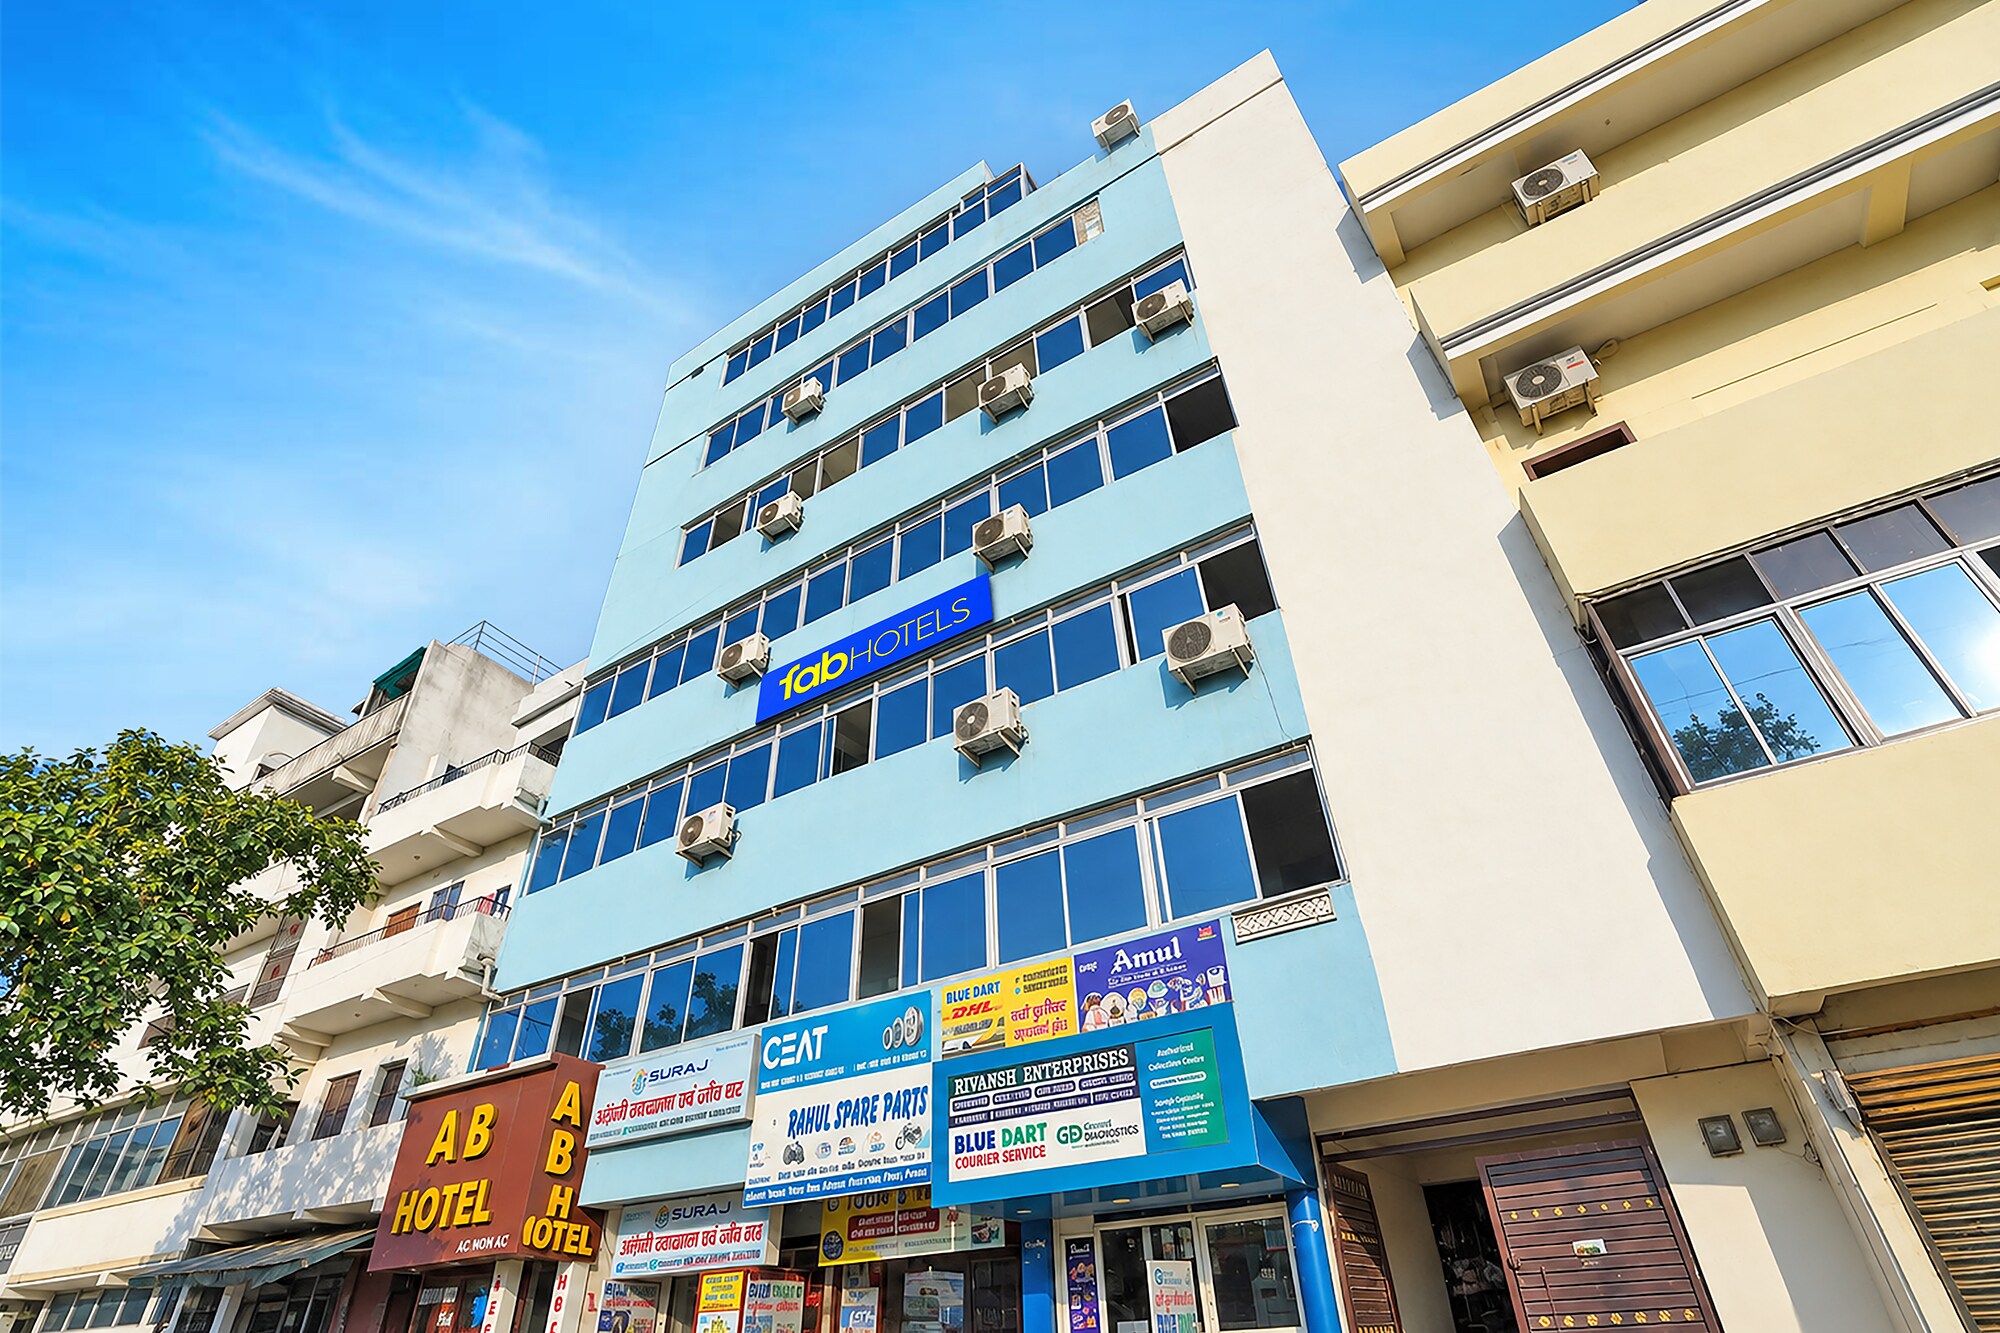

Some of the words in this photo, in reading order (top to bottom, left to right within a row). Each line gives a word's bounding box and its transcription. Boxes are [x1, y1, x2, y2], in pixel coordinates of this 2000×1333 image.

[1110, 936, 1182, 974] Amul
[946, 987, 971, 1004] BLUE
[973, 980, 1001, 998] DART
[952, 1000, 993, 1019] DHL
[763, 1025, 829, 1070] CEAT
[648, 1059, 709, 1082] SURAJ
[954, 1067, 1017, 1095] RIVANSH
[1023, 1048, 1129, 1083] ENTERPRISES
[787, 1103, 831, 1140] RAHUL
[834, 1094, 880, 1129] SPARE
[883, 1085, 929, 1122] PARTS
[954, 1129, 996, 1154] BLUE
[1001, 1122, 1048, 1148] DART
[955, 1152, 1000, 1170] COURIER
[1002, 1145, 1046, 1163] SERVICE
[390, 1178, 493, 1235] HOTEL
[672, 1201, 731, 1220] SURAJ
